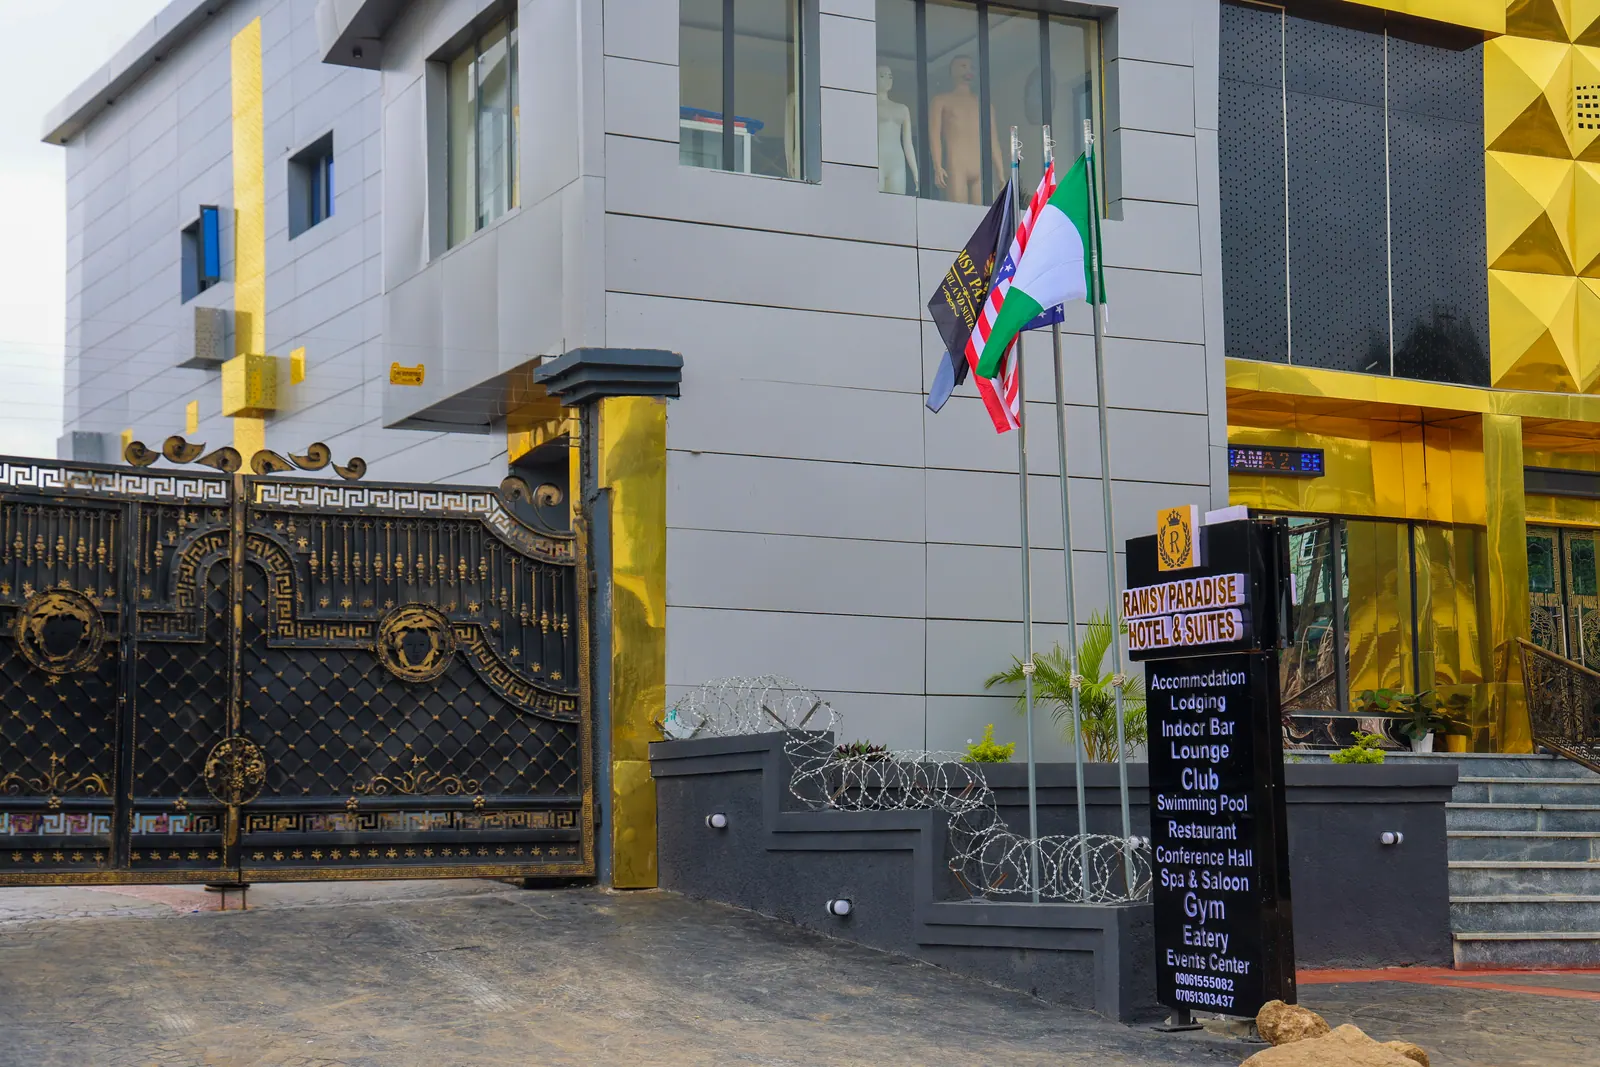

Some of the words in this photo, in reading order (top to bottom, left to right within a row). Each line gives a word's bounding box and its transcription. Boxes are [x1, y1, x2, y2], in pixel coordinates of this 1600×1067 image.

[951, 286, 965, 306] AND
[1169, 530, 1179, 553] R
[1122, 585, 1166, 617] RAMSY
[1168, 575, 1237, 612] PARADISE
[1128, 620, 1169, 648] HOTEL
[1172, 616, 1182, 643] &
[1186, 611, 1235, 644] SUITES
[1170, 693, 1226, 713] Lodging
[1162, 719, 1206, 737] Indoor
[1209, 717, 1235, 736] Bar
[1171, 741, 1229, 763] Lounge
[1181, 767, 1219, 790] Club
[1157, 794, 1217, 815] Swimming
[1220, 794, 1248, 811] Pool
[1168, 820, 1237, 840] Restaurant
[1156, 845, 1224, 866] Conference
[1228, 848, 1253, 867] Hall
[1161, 868, 1185, 891] Spa
[1188, 869, 1198, 888] &
[1201, 870, 1249, 891] Saloon
[1184, 891, 1225, 925] Gym
[1183, 924, 1229, 954] Eatery
[1166, 948, 1206, 970] Events
[1209, 953, 1250, 974] Center
[1175, 972, 1234, 991] 09061555082
[1175, 989, 1234, 1008] 07051303437
